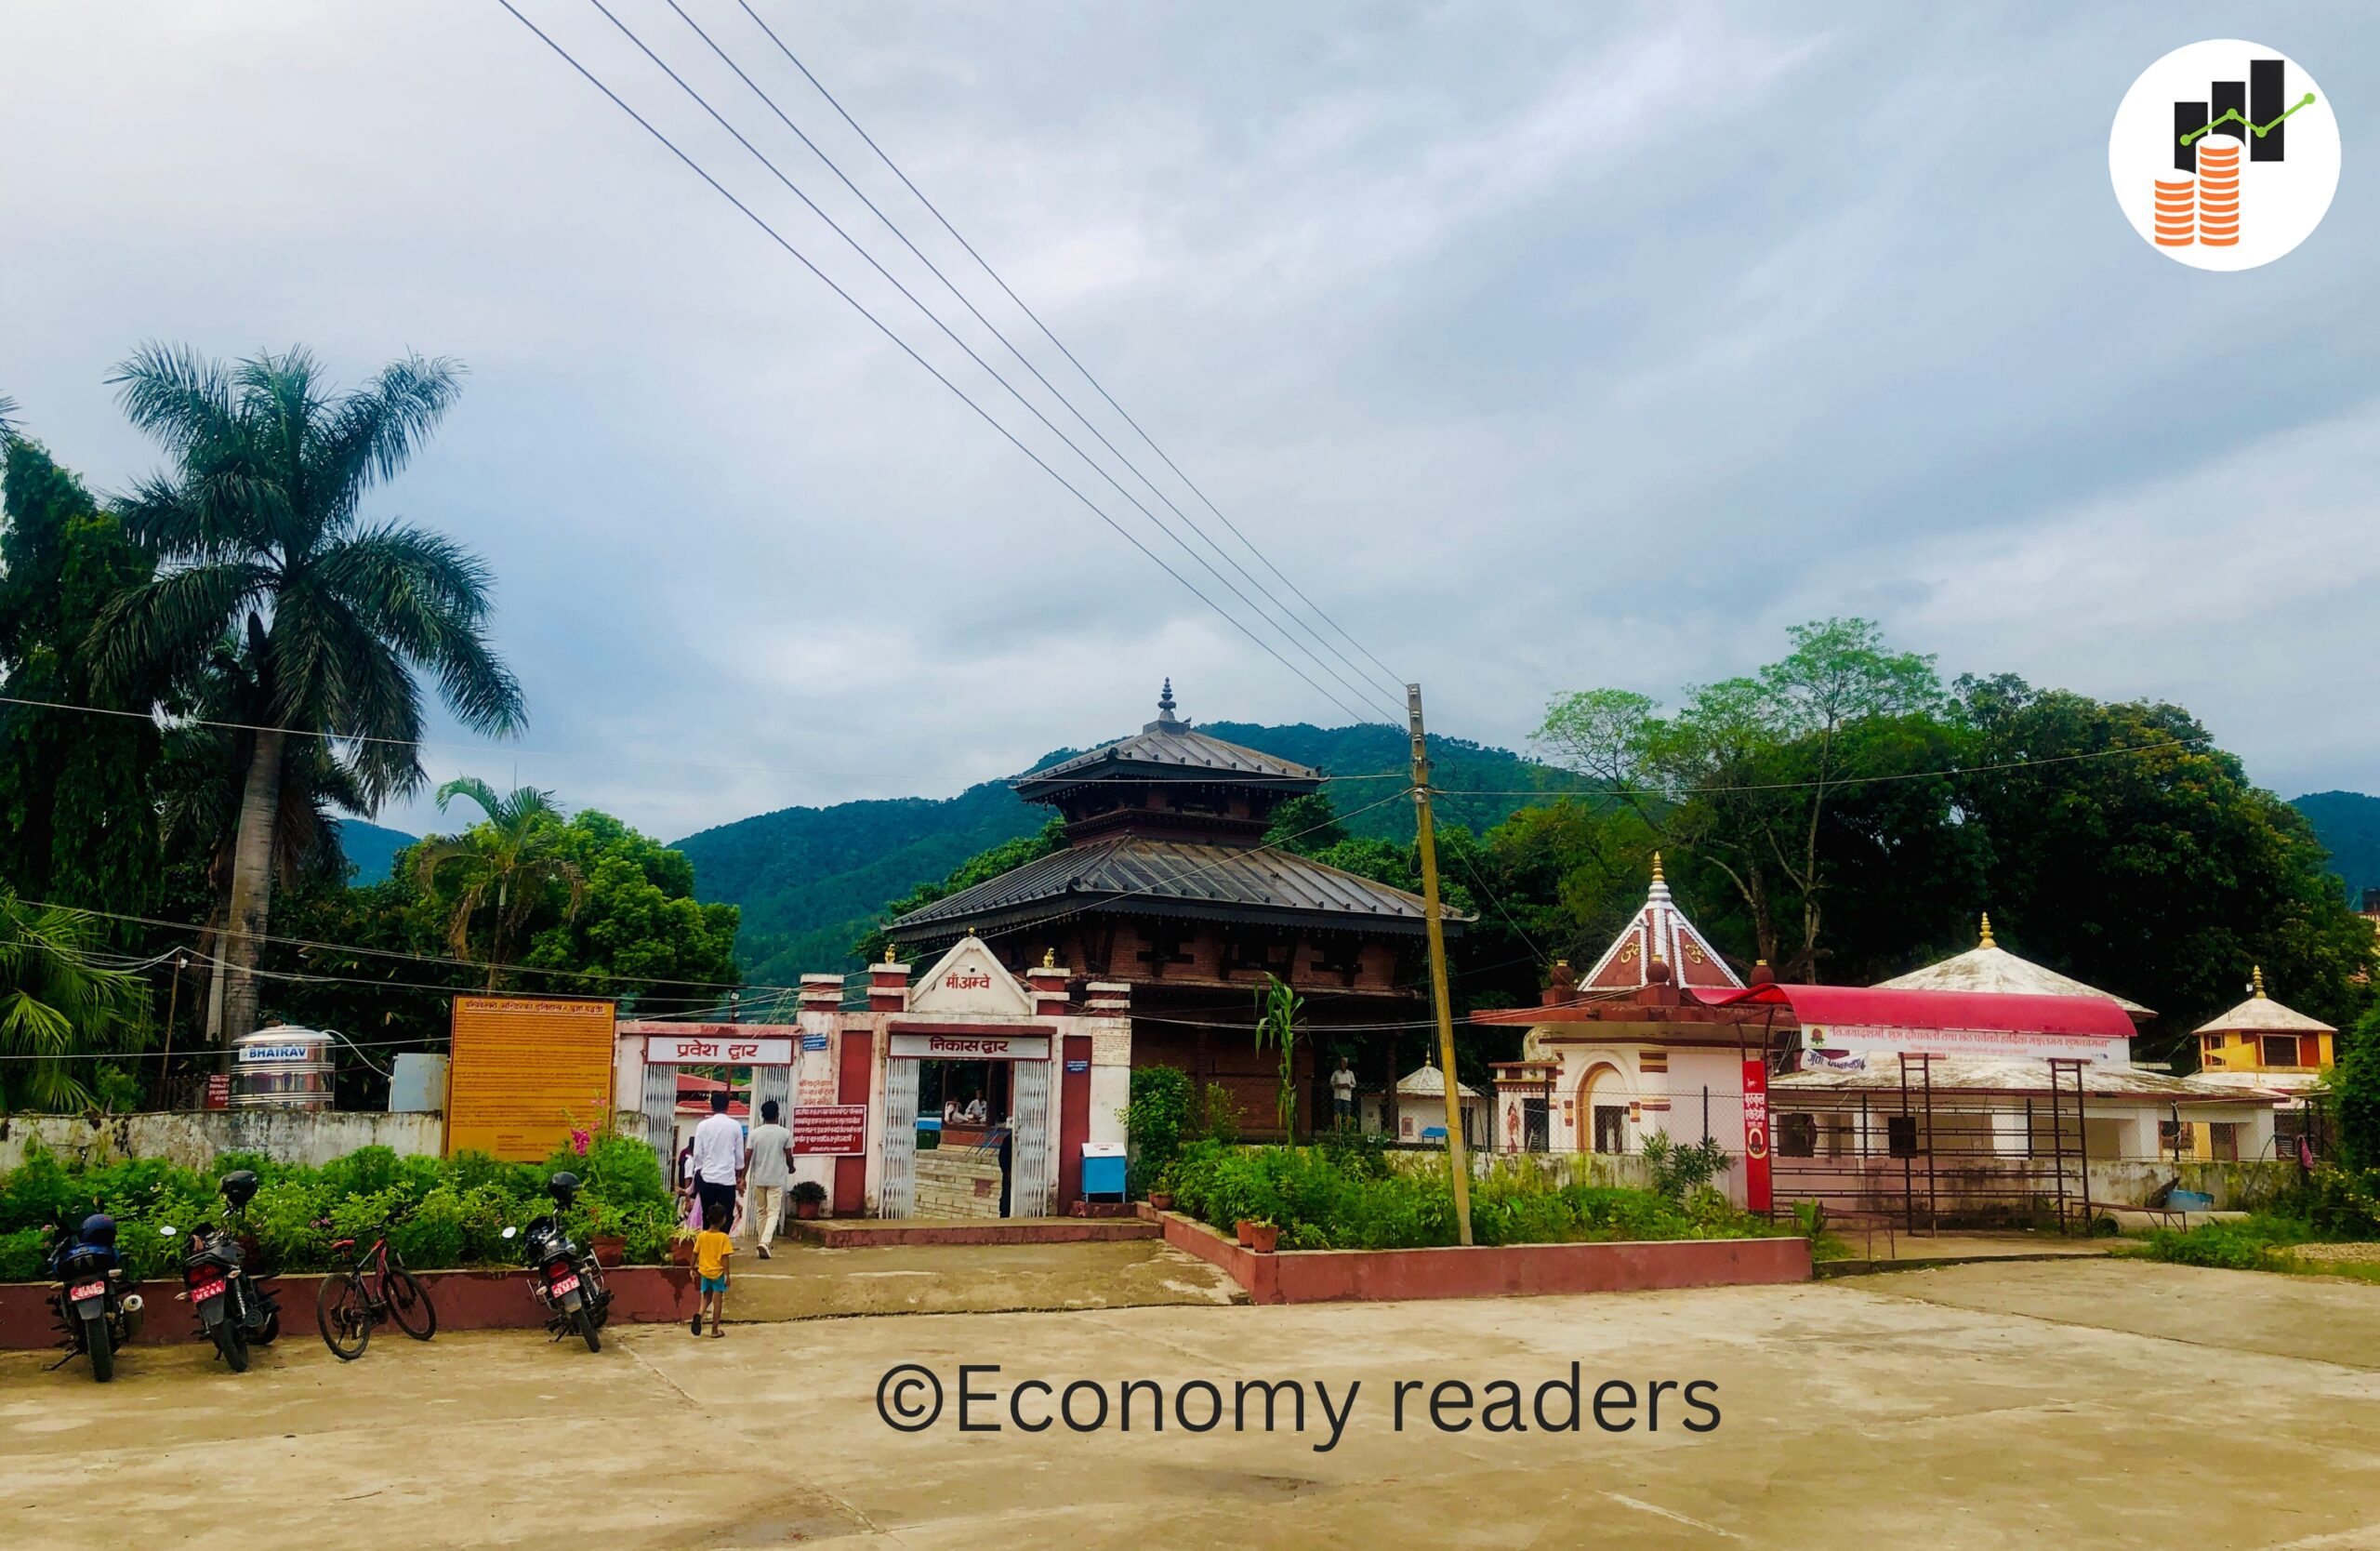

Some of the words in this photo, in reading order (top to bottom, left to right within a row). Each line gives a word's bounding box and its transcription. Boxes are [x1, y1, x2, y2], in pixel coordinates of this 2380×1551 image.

[249, 1047, 307, 1058] BHAIRAV
[676, 1039, 720, 1057] प्रवेश
[728, 1043, 760, 1060] द्वार
[929, 1036, 980, 1053] निकास
[981, 1040, 1010, 1054] द्वार
